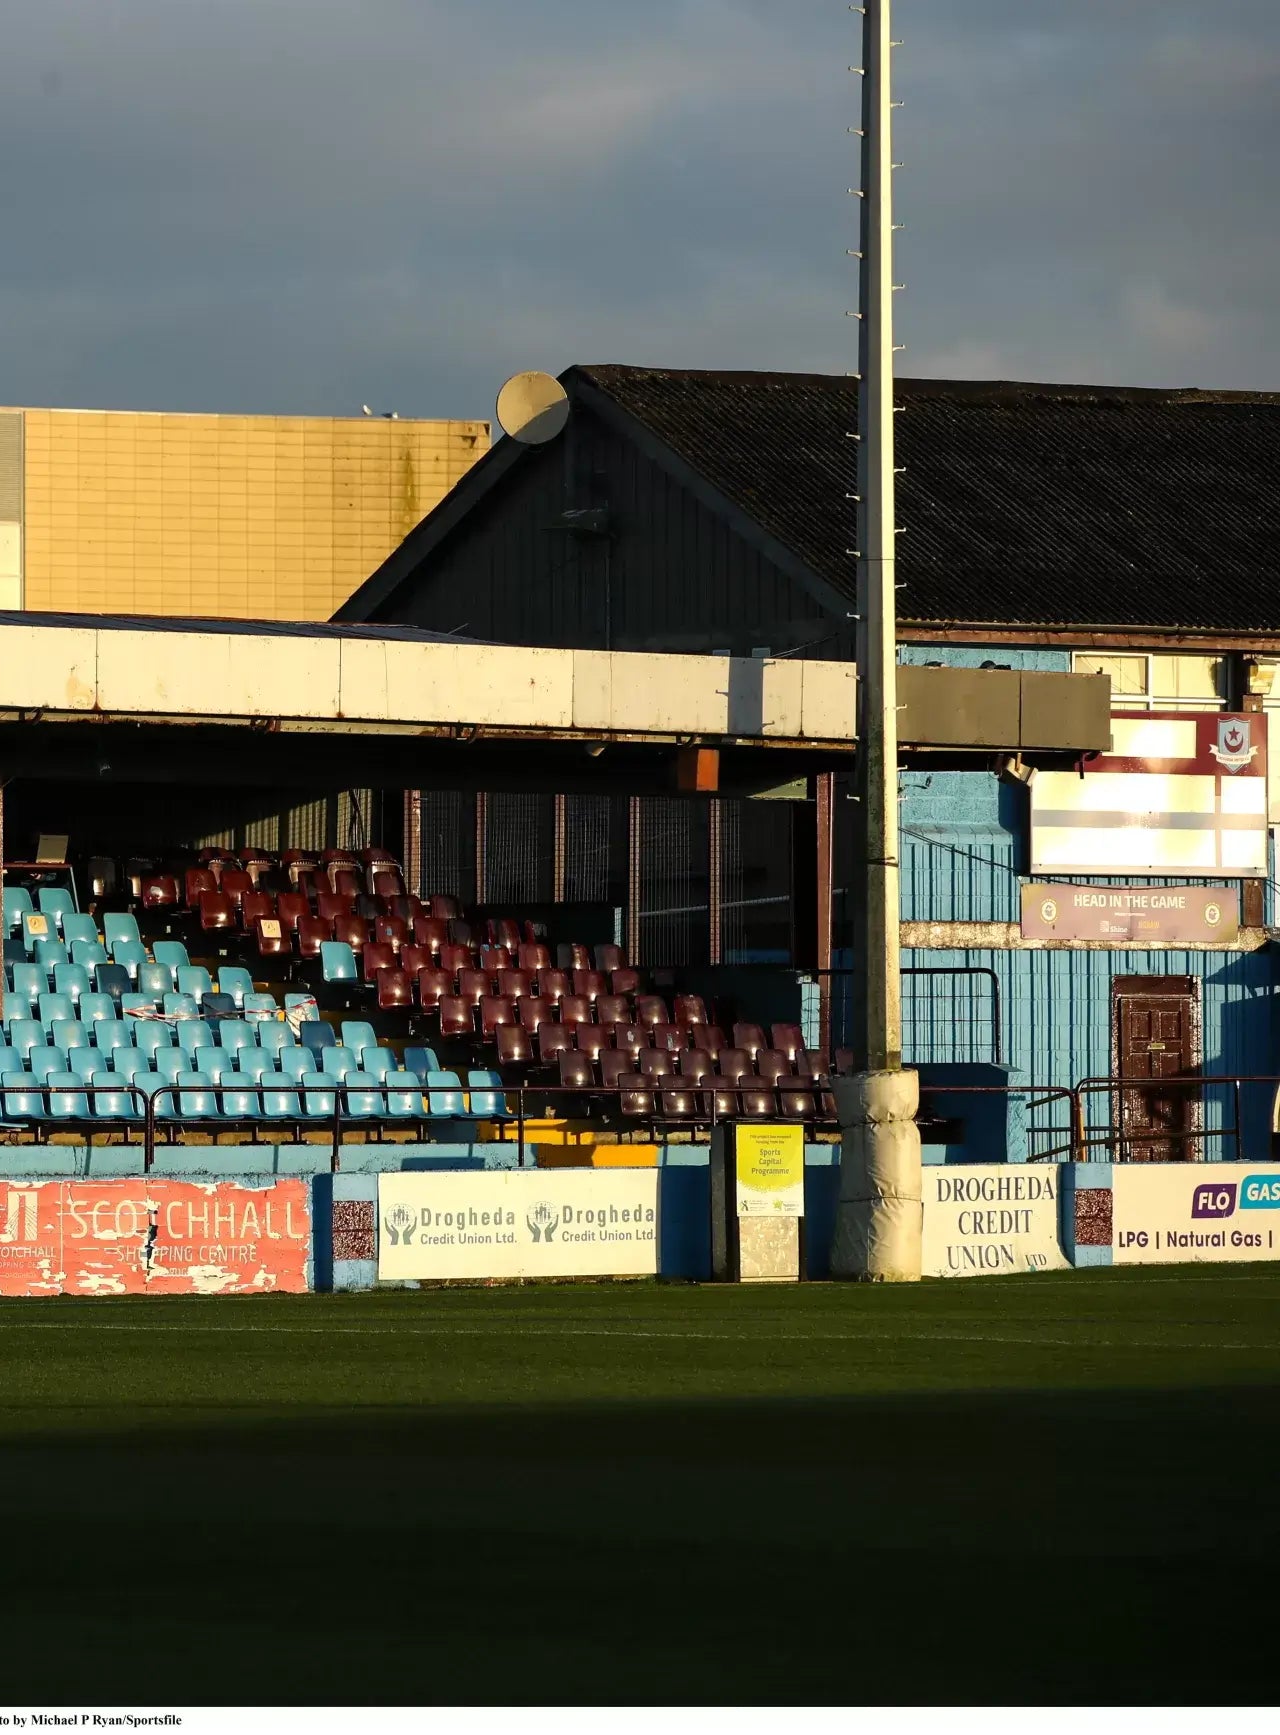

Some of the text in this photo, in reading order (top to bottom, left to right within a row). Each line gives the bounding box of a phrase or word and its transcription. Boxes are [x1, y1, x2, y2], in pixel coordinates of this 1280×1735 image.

[1074, 894, 1186, 909] HEAD IN THE GAME
[1109, 925, 1128, 933] Shine
[759, 1158, 782, 1166] Capital
[760, 1149, 781, 1157] Sports
[751, 1167, 790, 1176] Programme
[936, 1176, 1055, 1202] DROGHEDA
[1198, 1192, 1230, 1211] FLO
[420, 1206, 515, 1231] Drogheda
[562, 1203, 654, 1228] Drogheda
[958, 1209, 1034, 1235] CREDIT
[420, 1232, 518, 1245] Credit Union Ltd.
[562, 1229, 657, 1242] Credit Union Ltd.
[1119, 1230, 1262, 1248] LPG Natural Gas
[199, 1244, 257, 1263] CENTRE
[946, 1244, 1047, 1270] UNION LTD
